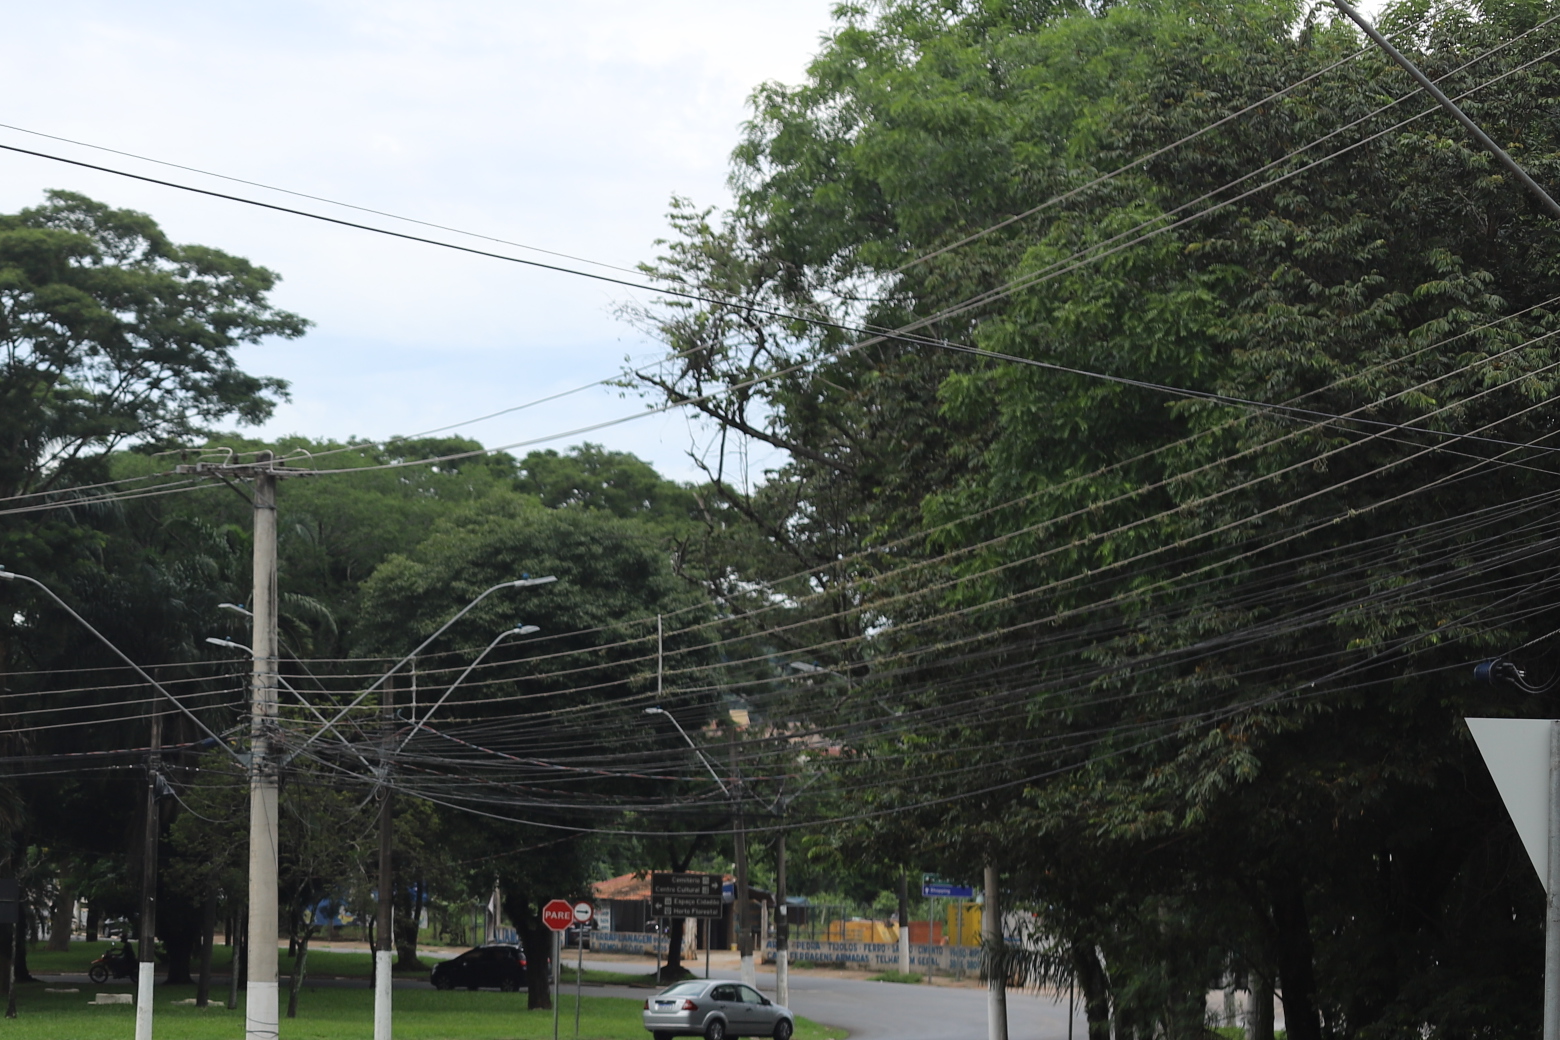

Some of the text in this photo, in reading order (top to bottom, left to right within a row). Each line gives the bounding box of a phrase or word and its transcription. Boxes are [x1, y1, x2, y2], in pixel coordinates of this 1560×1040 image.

[674, 898, 695, 906] Espaço
[545, 911, 571, 920] PARE
[796, 942, 821, 950] PEDRA
[828, 942, 857, 951] TIJOLOS
[864, 943, 886, 953] FERRO
[835, 953, 870, 963] ARMADAS
